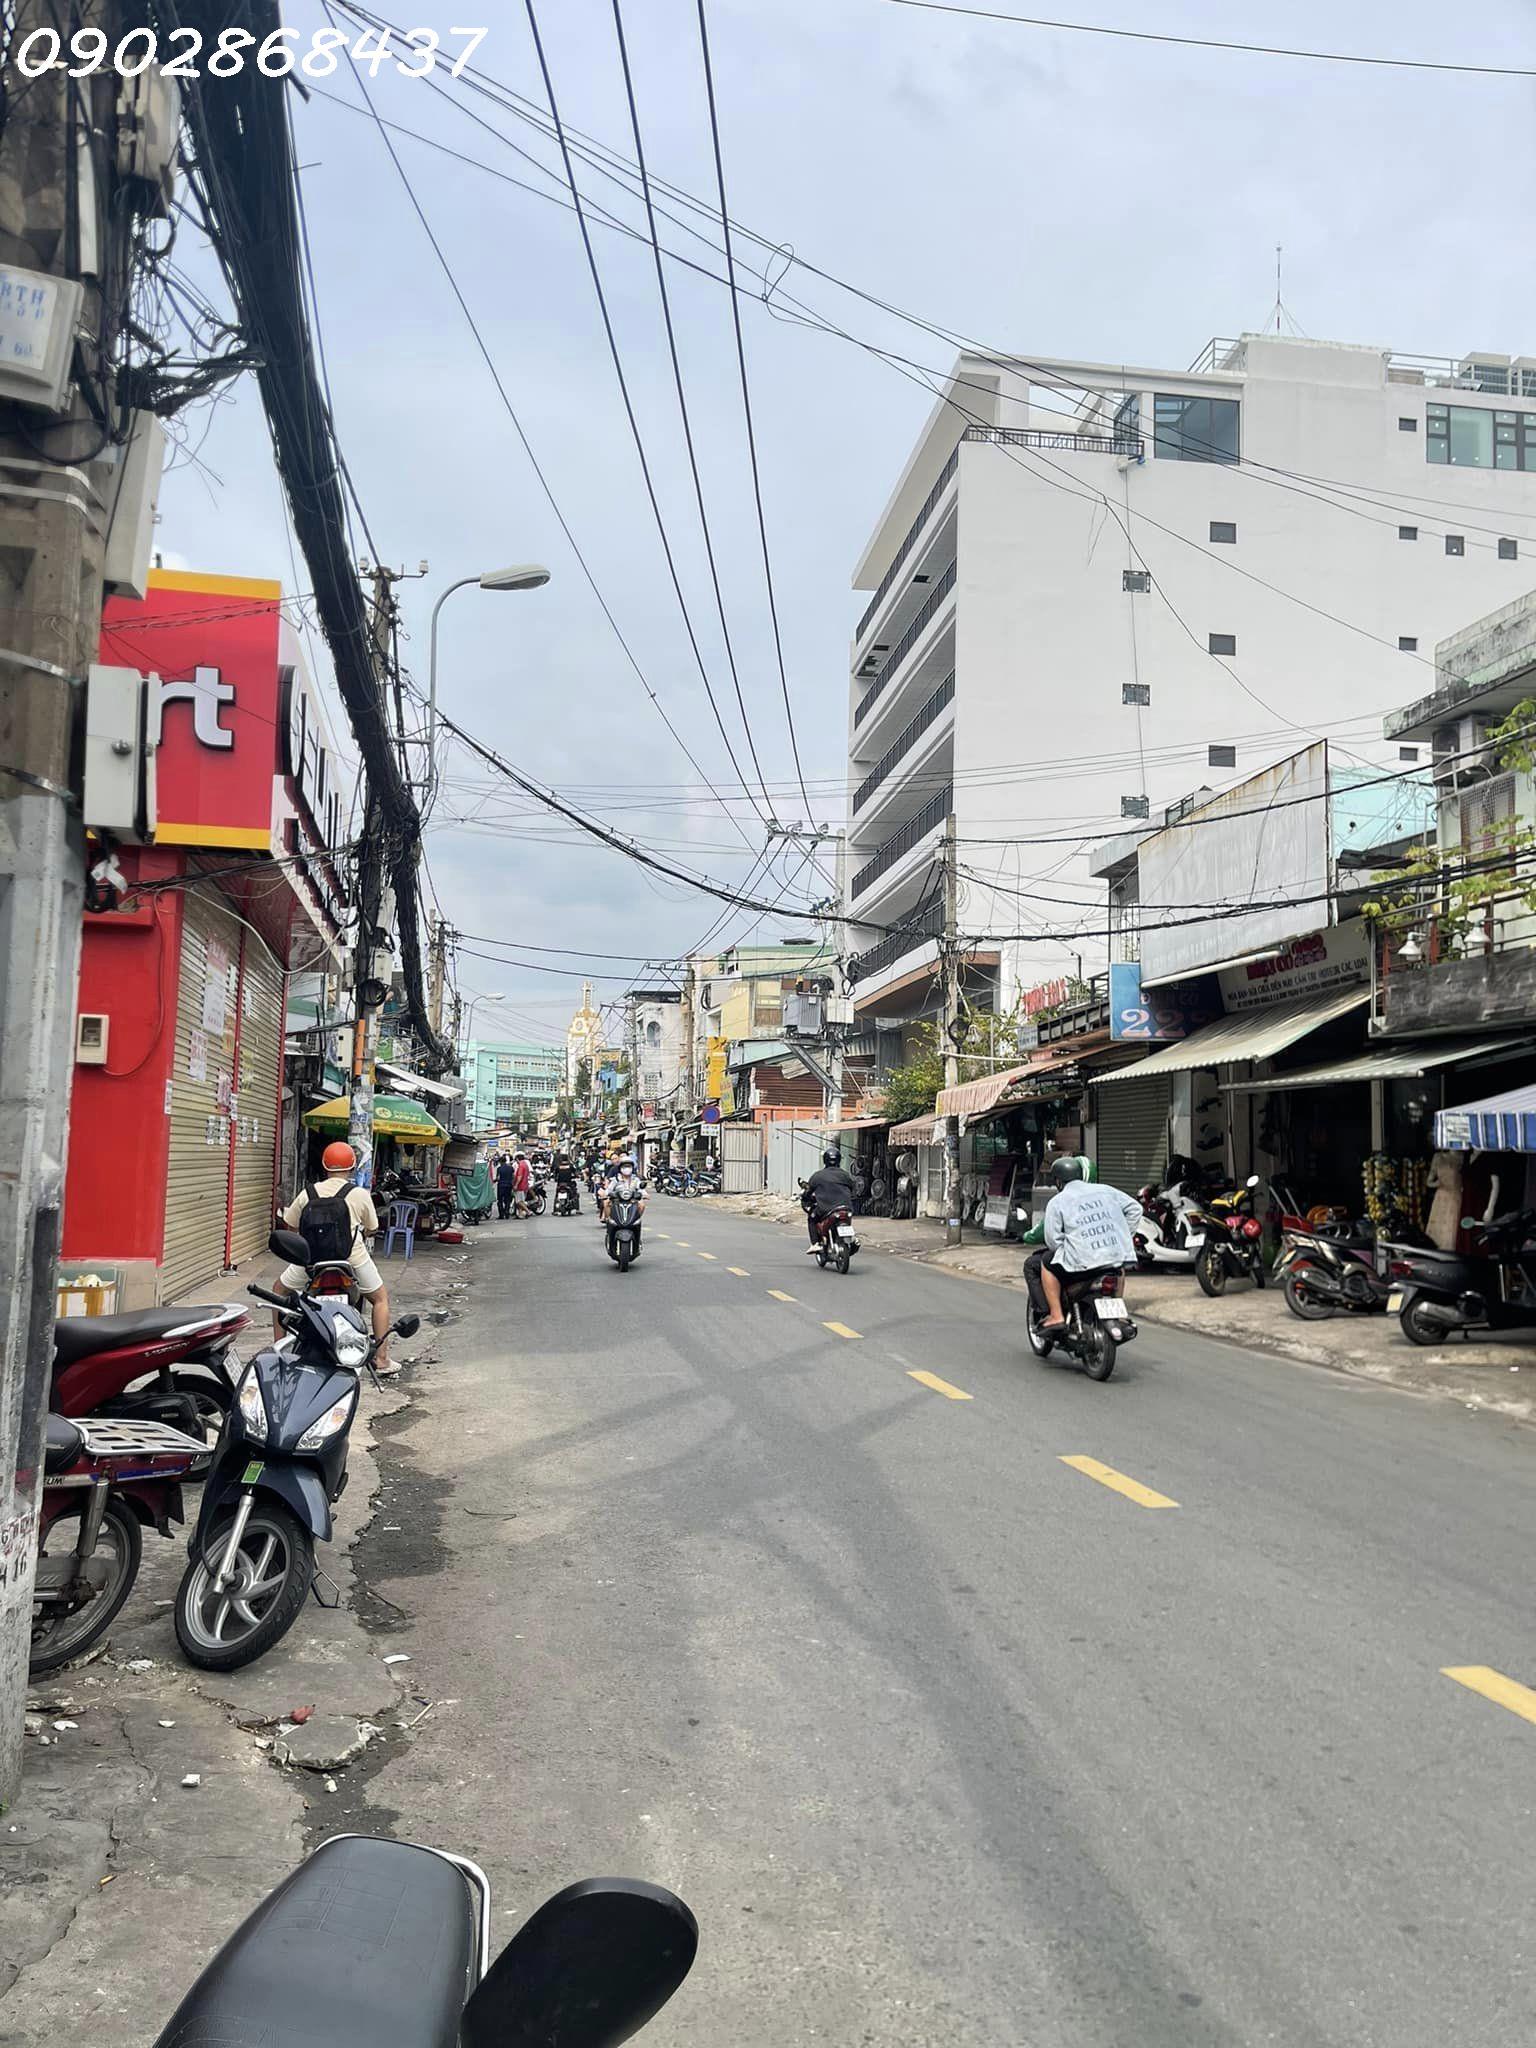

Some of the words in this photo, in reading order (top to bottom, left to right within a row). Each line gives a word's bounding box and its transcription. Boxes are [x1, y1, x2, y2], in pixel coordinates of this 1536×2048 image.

[1078, 1199, 1103, 1212] ANTI
[1075, 1211, 1112, 1226] SOCIAL
[1080, 1223, 1116, 1239] SOCIAL
[1091, 1236, 1118, 1250] CLUB
